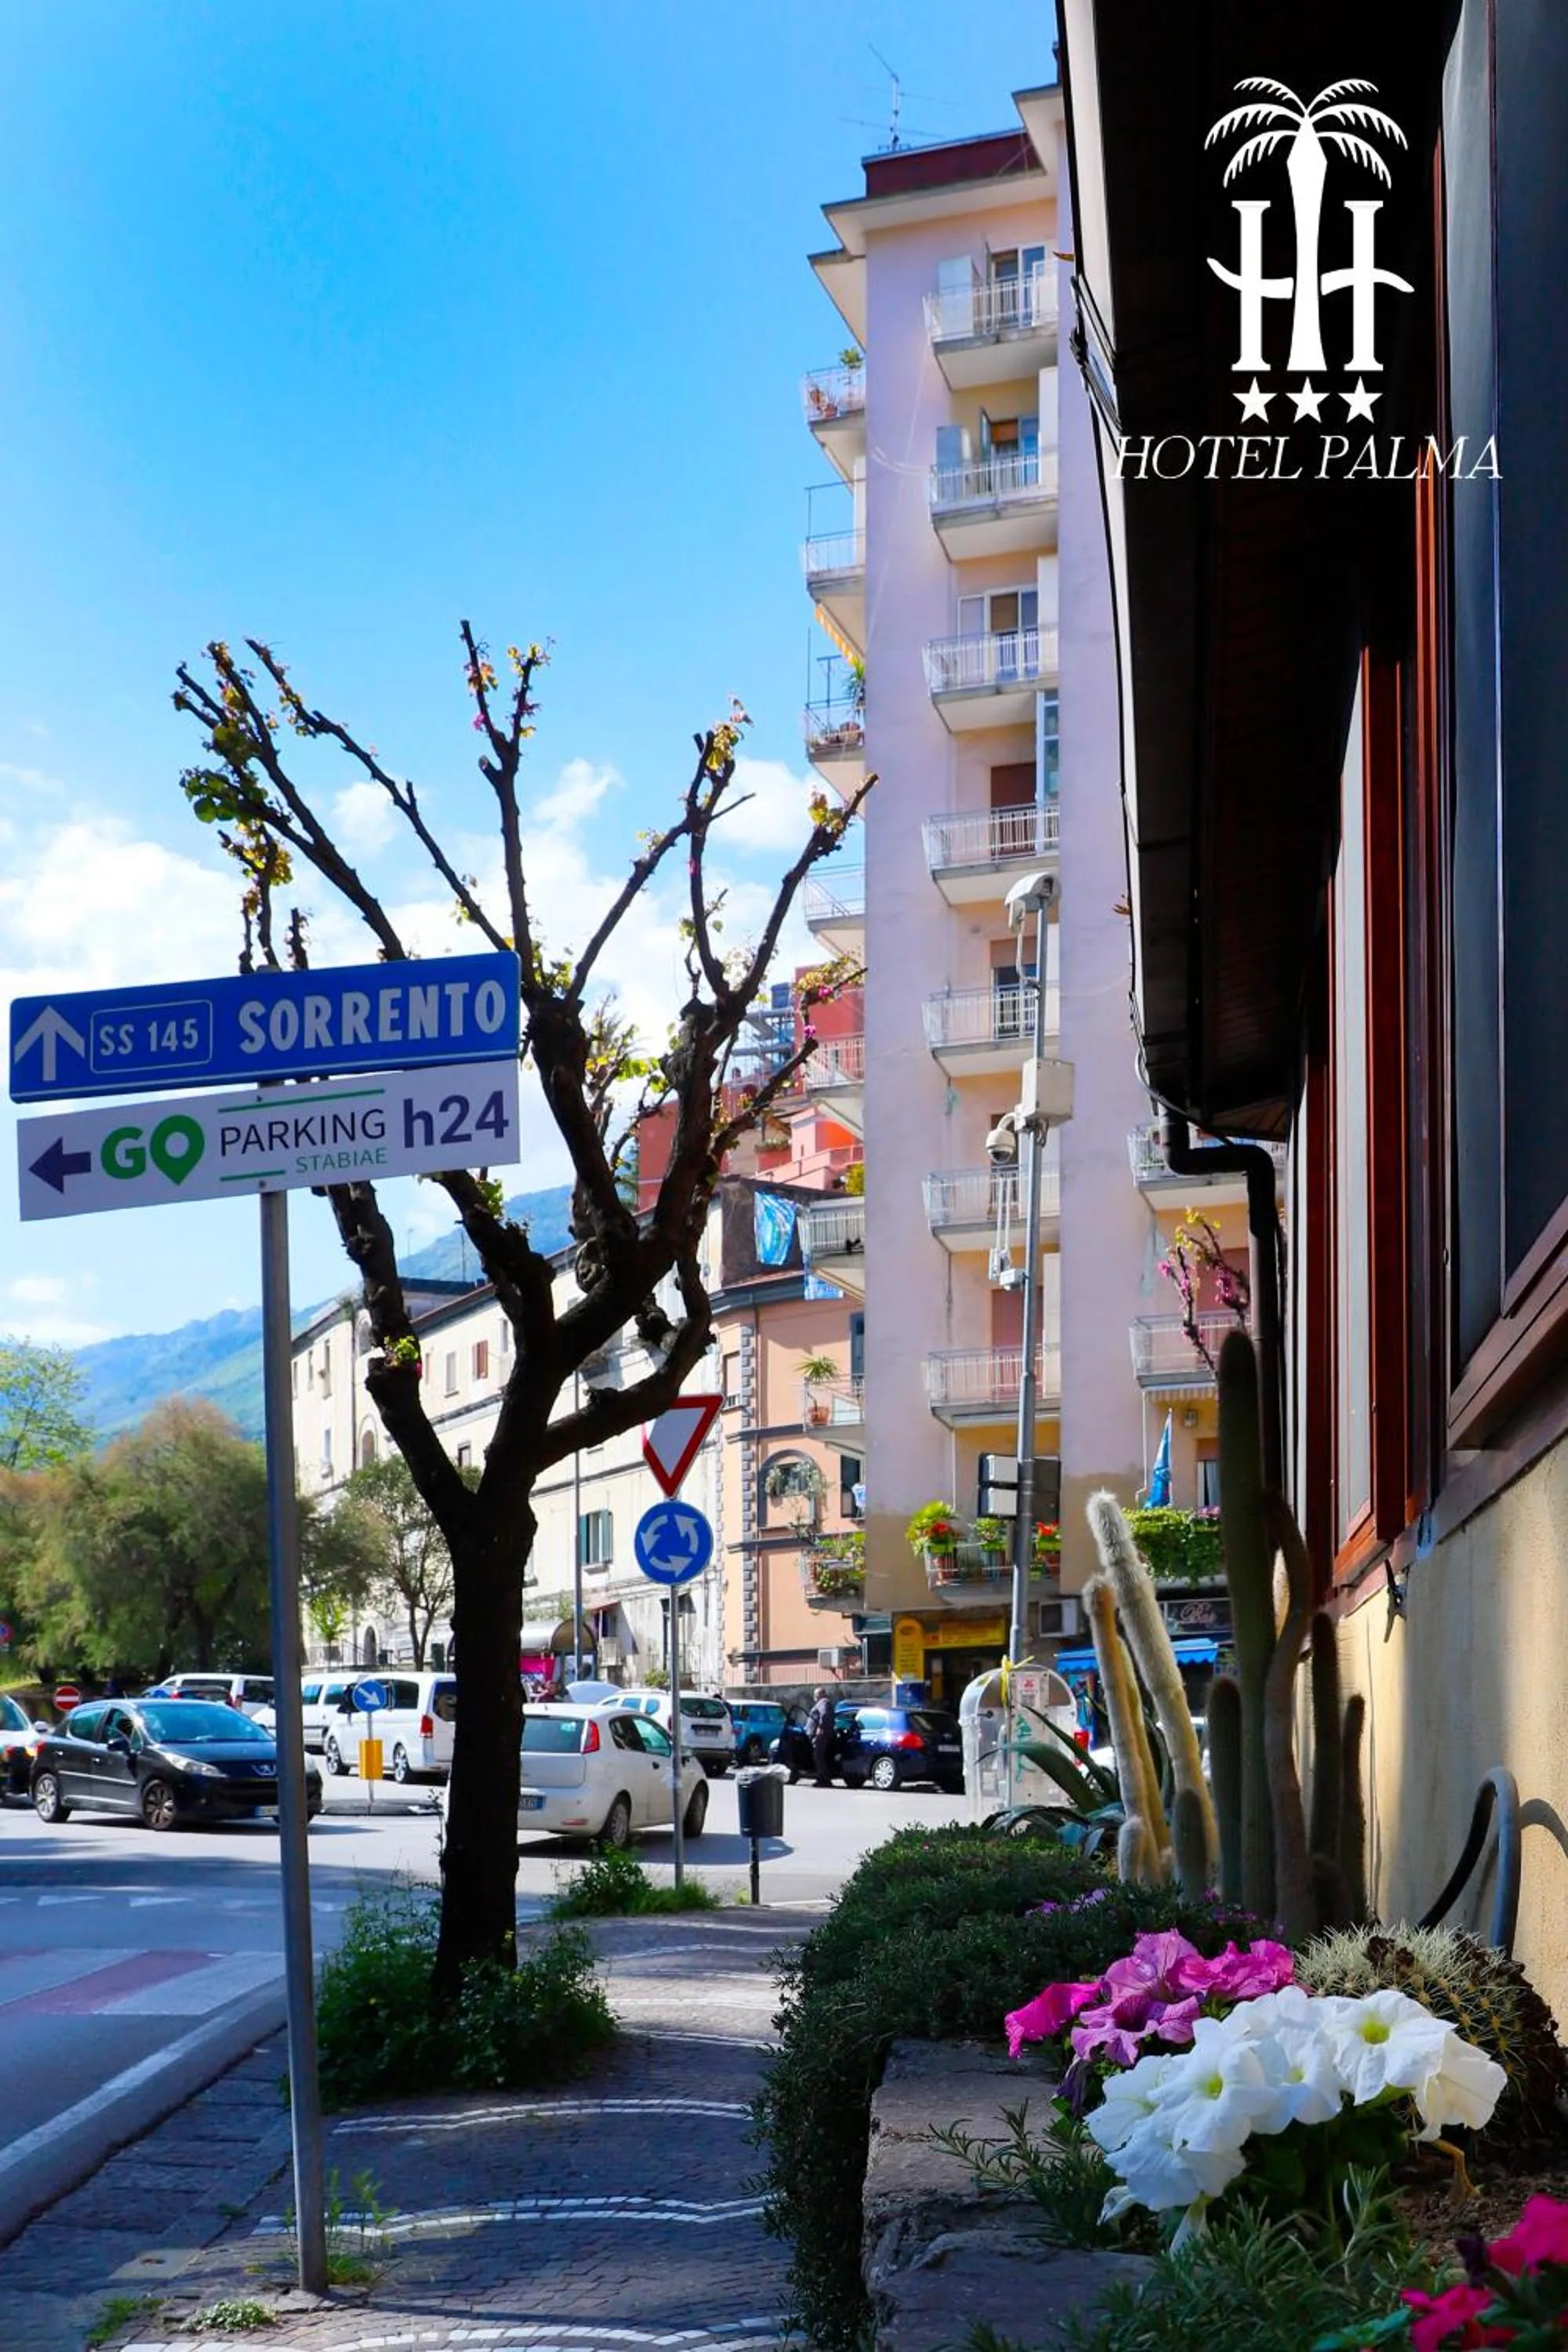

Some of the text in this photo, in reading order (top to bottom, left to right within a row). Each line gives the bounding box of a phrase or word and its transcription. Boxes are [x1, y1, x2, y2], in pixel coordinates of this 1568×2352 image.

[99, 980, 506, 1056] SS 145 SORRENTO
[100, 1091, 509, 1185] GO PARKING h24
[296, 1147, 387, 1174] STABIAE
